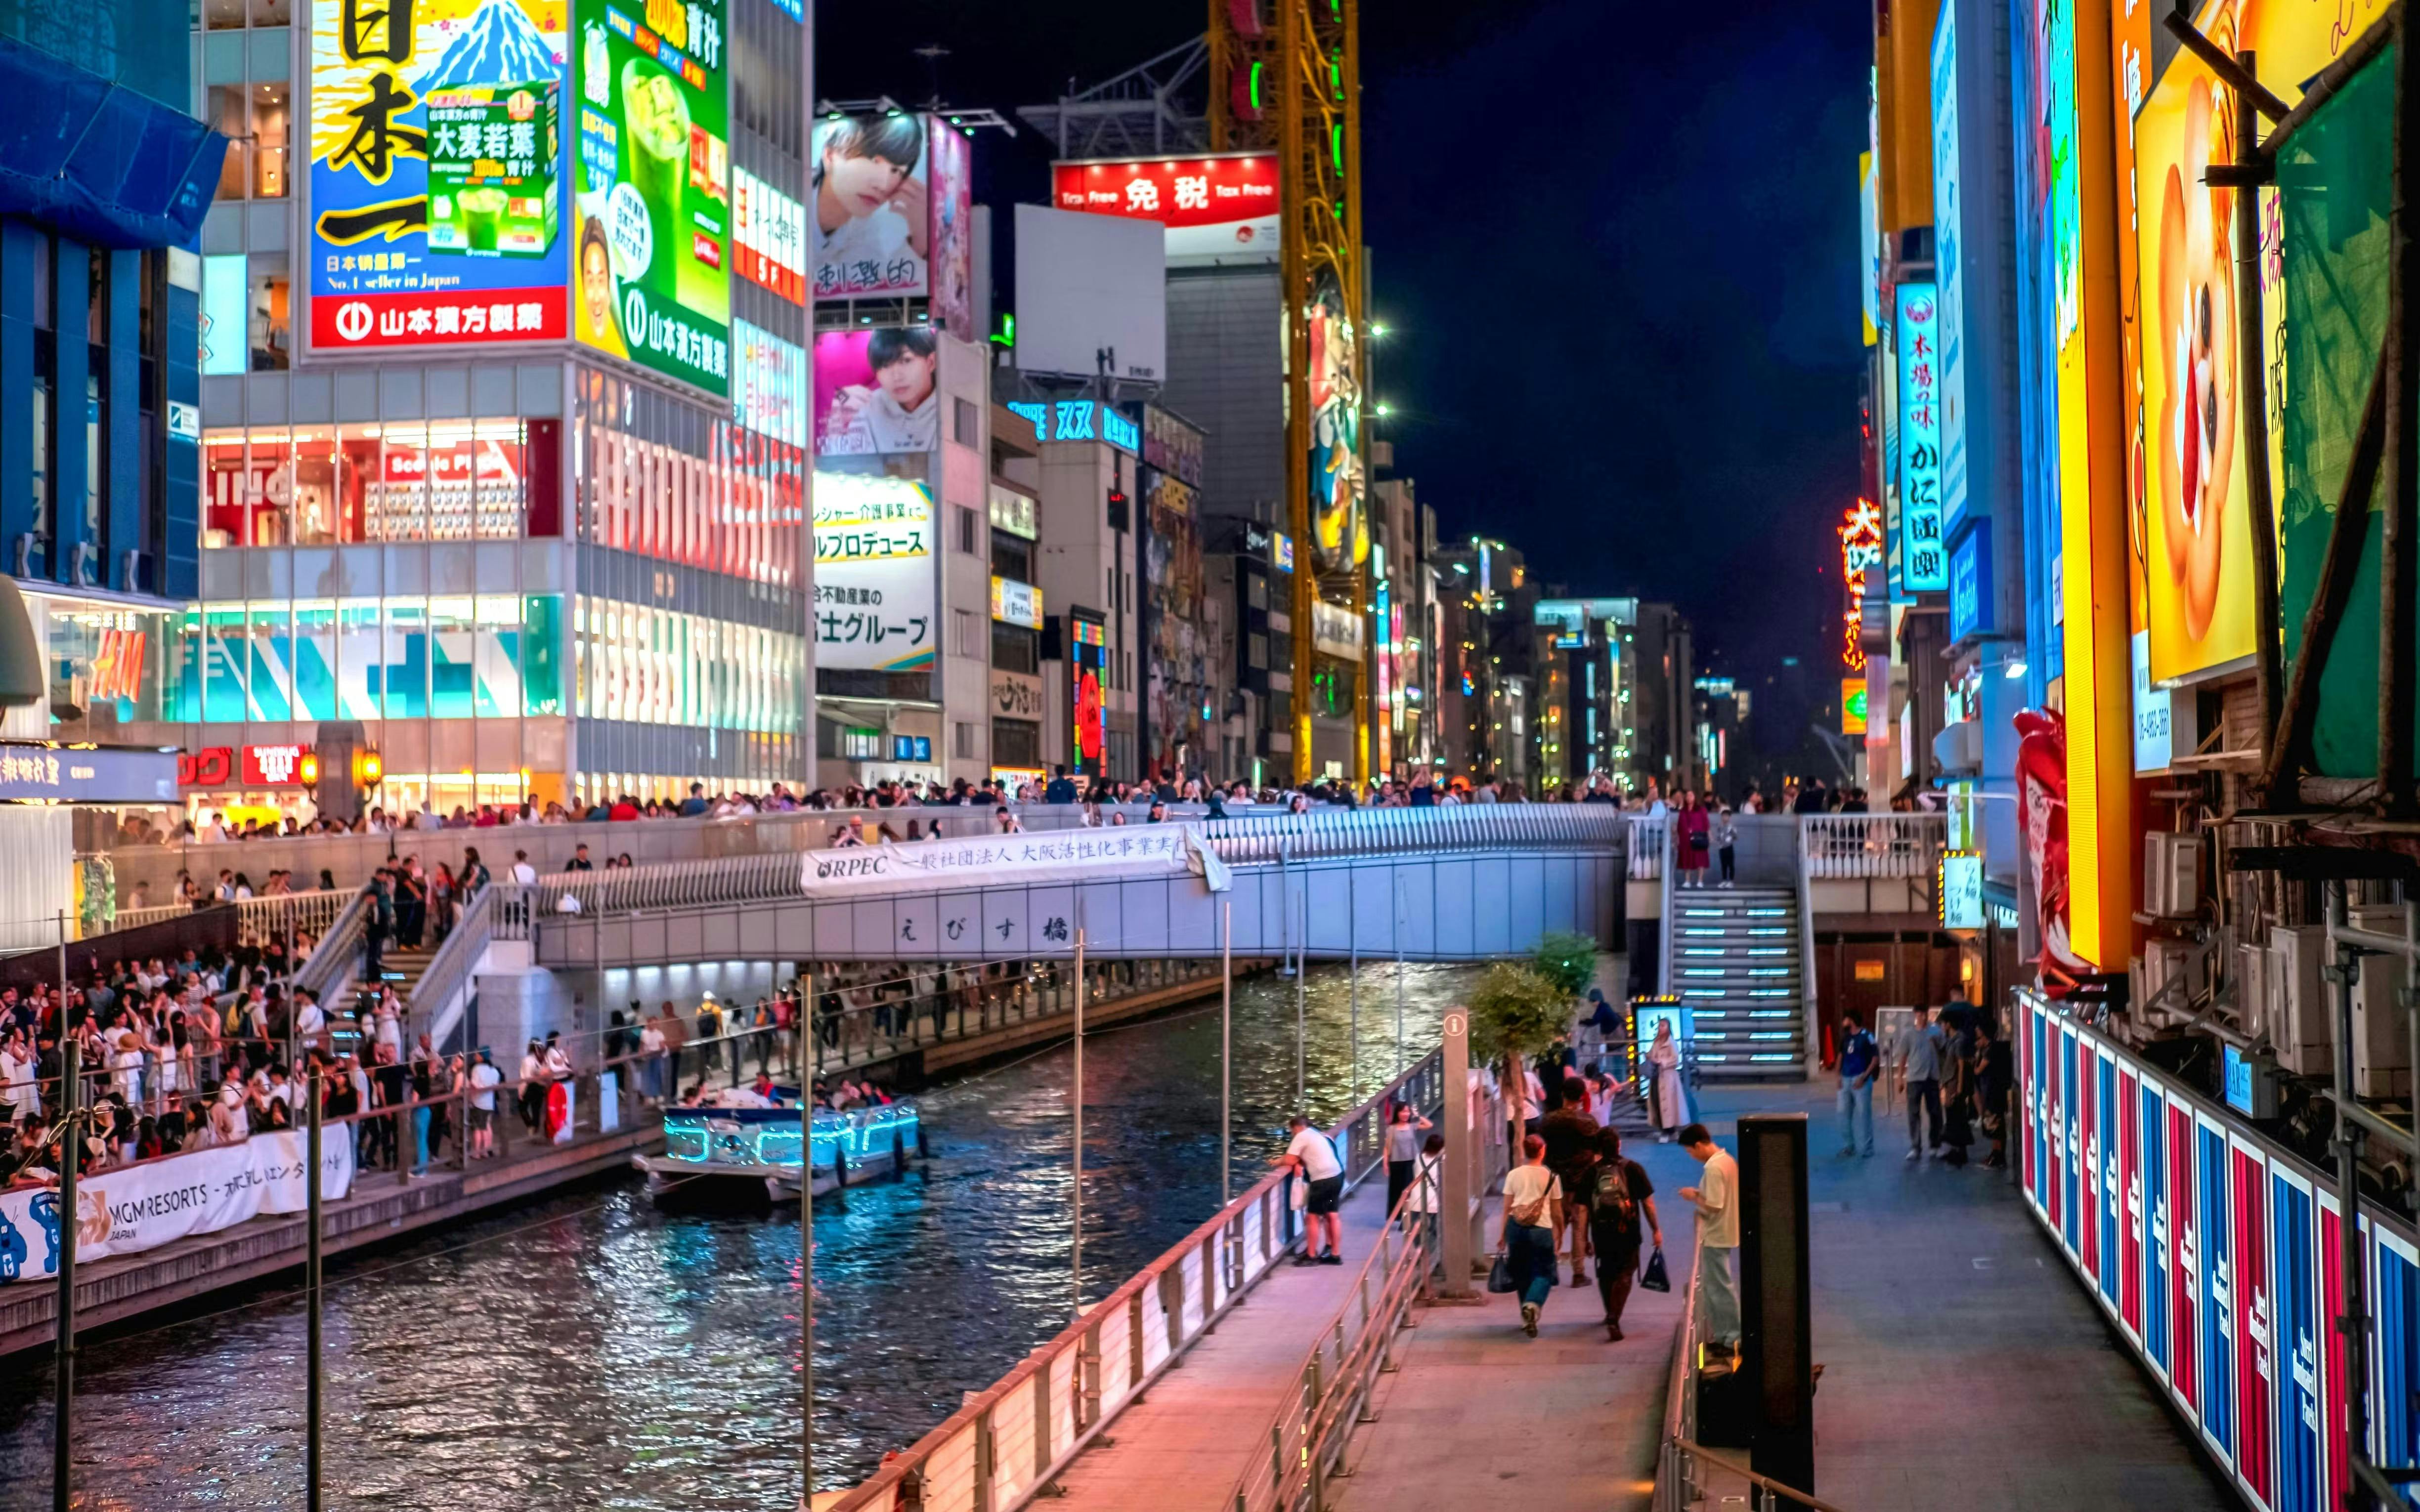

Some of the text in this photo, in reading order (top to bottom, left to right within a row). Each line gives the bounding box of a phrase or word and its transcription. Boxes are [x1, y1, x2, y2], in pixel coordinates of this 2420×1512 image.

[433, 122, 536, 159] 大麦若葉
[1062, 175, 1273, 211] Tax Free 免税 Tax Free
[421, 273, 460, 290] Japan
[817, 258, 915, 291] 刺激的
[380, 303, 543, 336] 山本漢方製薬
[649, 311, 727, 379] 山本漢方製薬
[903, 847, 1012, 870] 一般社団法人
[902, 917, 1068, 941] えびす橋
[109, 1183, 208, 1226] MGM RESORTS
[108, 1228, 137, 1241] JAPAN
